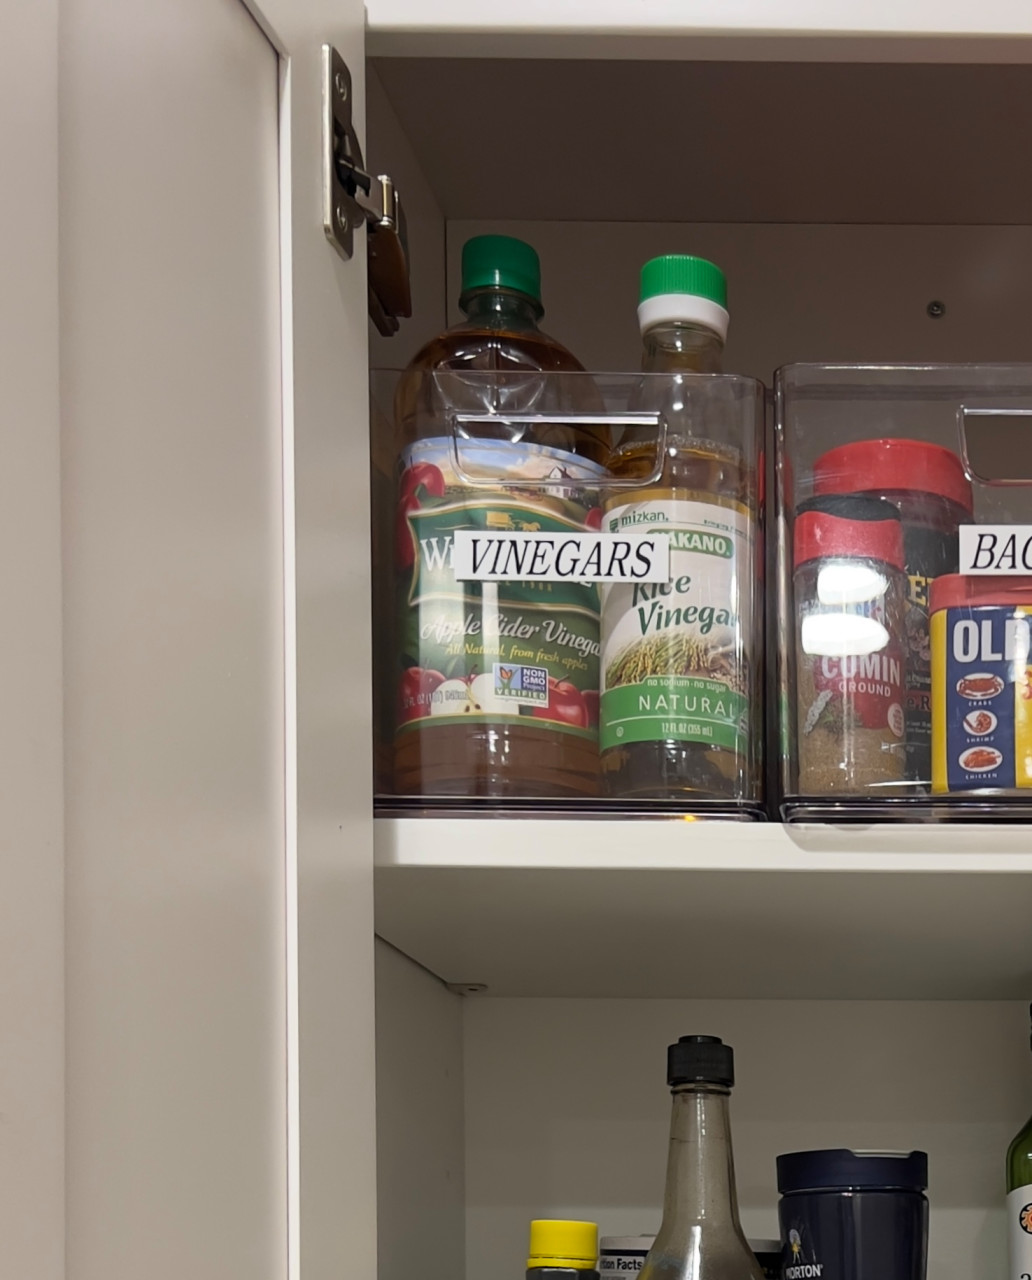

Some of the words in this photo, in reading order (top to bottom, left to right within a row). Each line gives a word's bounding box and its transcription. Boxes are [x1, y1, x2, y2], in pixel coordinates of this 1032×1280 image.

[471, 538, 656, 579] VINEGARS
[632, 575, 692, 607] Rice
[420, 613, 481, 644] Apple
[542, 619, 601, 657] Vinega
[953, 618, 1027, 663] OLD
[509, 644, 534, 659] from
[536, 647, 560, 662] fresh
[561, 656, 588, 671] apples
[821, 655, 900, 683] CUMIN
[522, 668, 546, 678] NON
[522, 676, 546, 686] GMO
[496, 689, 546, 700] VERIFIED
[706, 681, 727, 693] sugar
[839, 681, 891, 698] GROUND
[639, 694, 735, 719] NATURAL
[616, 1255, 642, 1270] Facts
